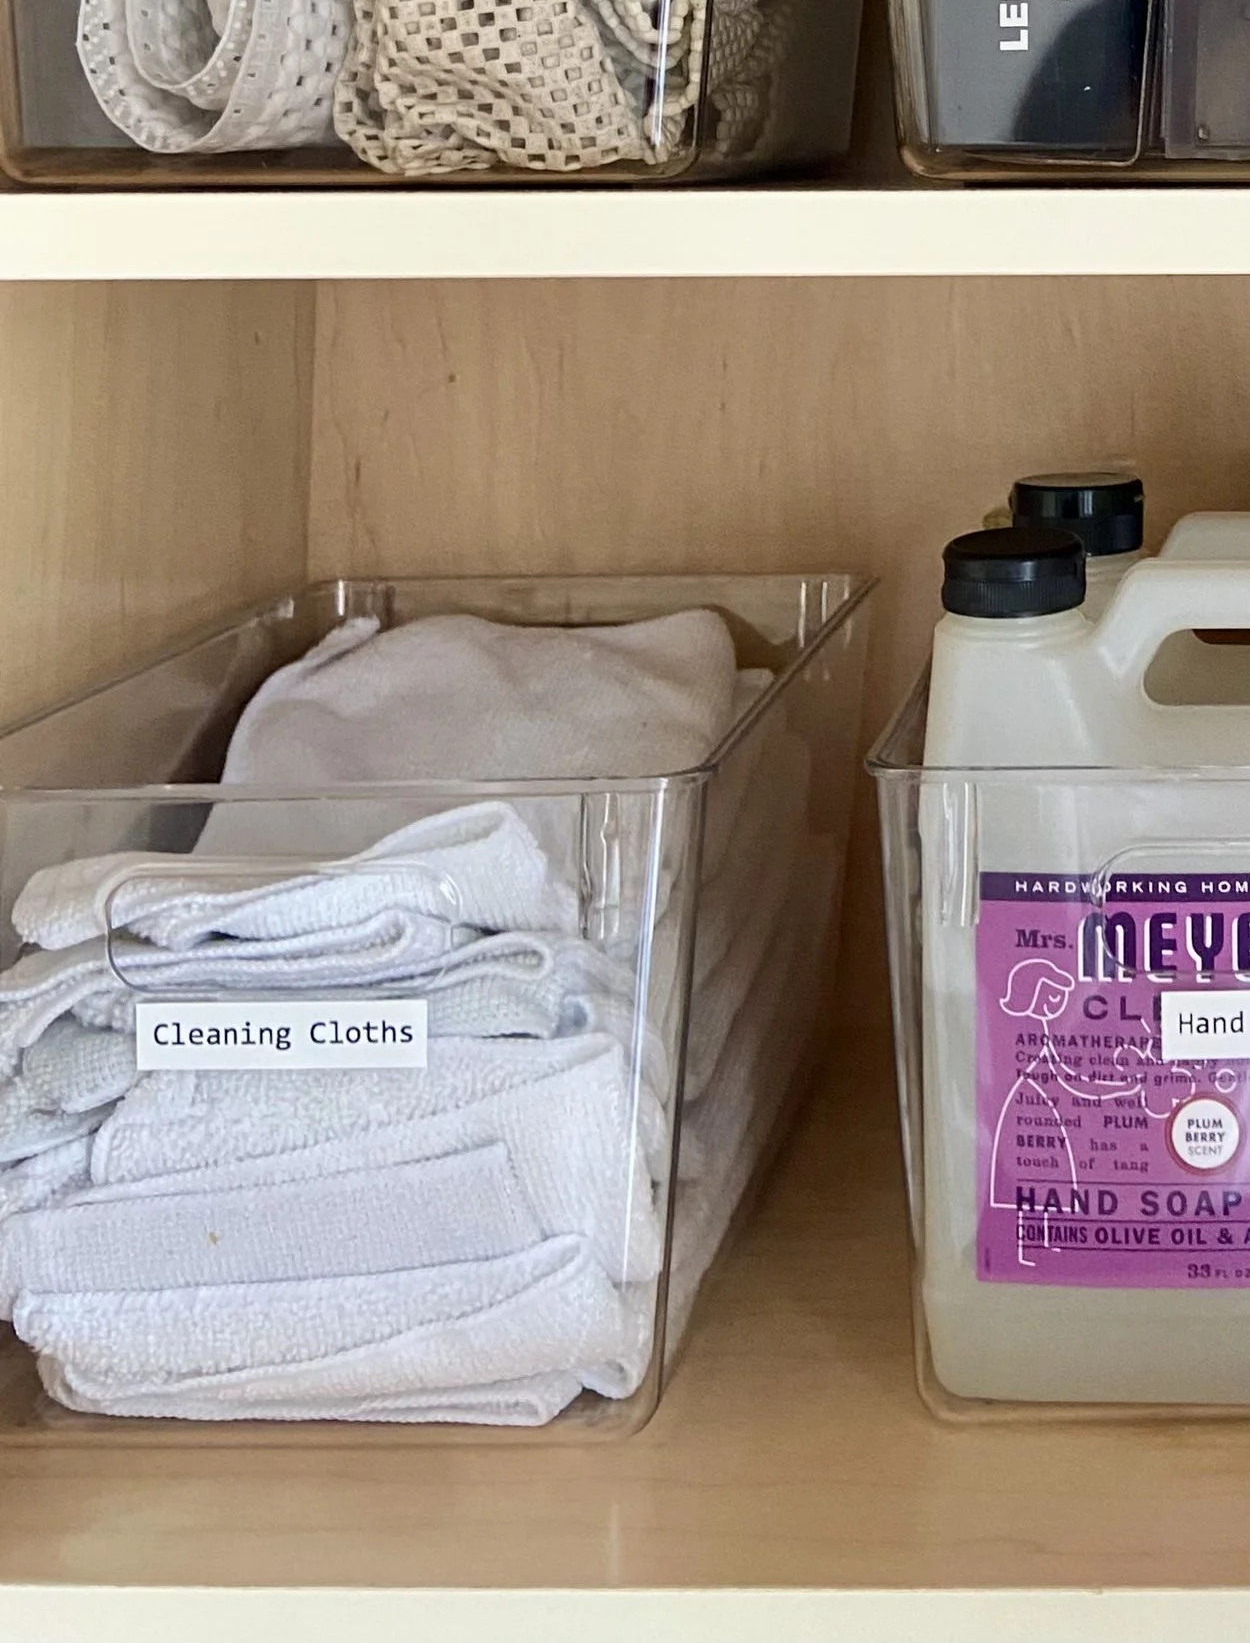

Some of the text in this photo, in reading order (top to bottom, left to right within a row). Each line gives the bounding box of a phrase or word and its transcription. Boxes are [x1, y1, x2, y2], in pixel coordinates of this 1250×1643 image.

[1015, 879, 1189, 895] HARDWORKING
[1015, 928, 1074, 950] Mrs.
[1178, 1009, 1245, 1035] Hand
[152, 1019, 414, 1052] Cleaning Cloths
[1015, 1033, 1162, 1049] AROMATHERAPE
[1103, 1115, 1149, 1130] PLUM
[1187, 1118, 1223, 1129] PLUM
[1016, 1134, 1066, 1149] BERRY
[1090, 1138, 1118, 1152] has
[1185, 1131, 1225, 1143] BERRY
[1188, 1146, 1223, 1156] SCENT
[1016, 1155, 1149, 1172] touch of tang
[1016, 1186, 1119, 1216] HAND
[1140, 1189, 1243, 1217] SOAP
[1016, 1223, 1088, 1244] CONTAINS
[1094, 1226, 1161, 1245] OLIVE
[1171, 1226, 1208, 1246] OIL
[1216, 1227, 1234, 1245] &
[1186, 1262, 1212, 1280] 33
